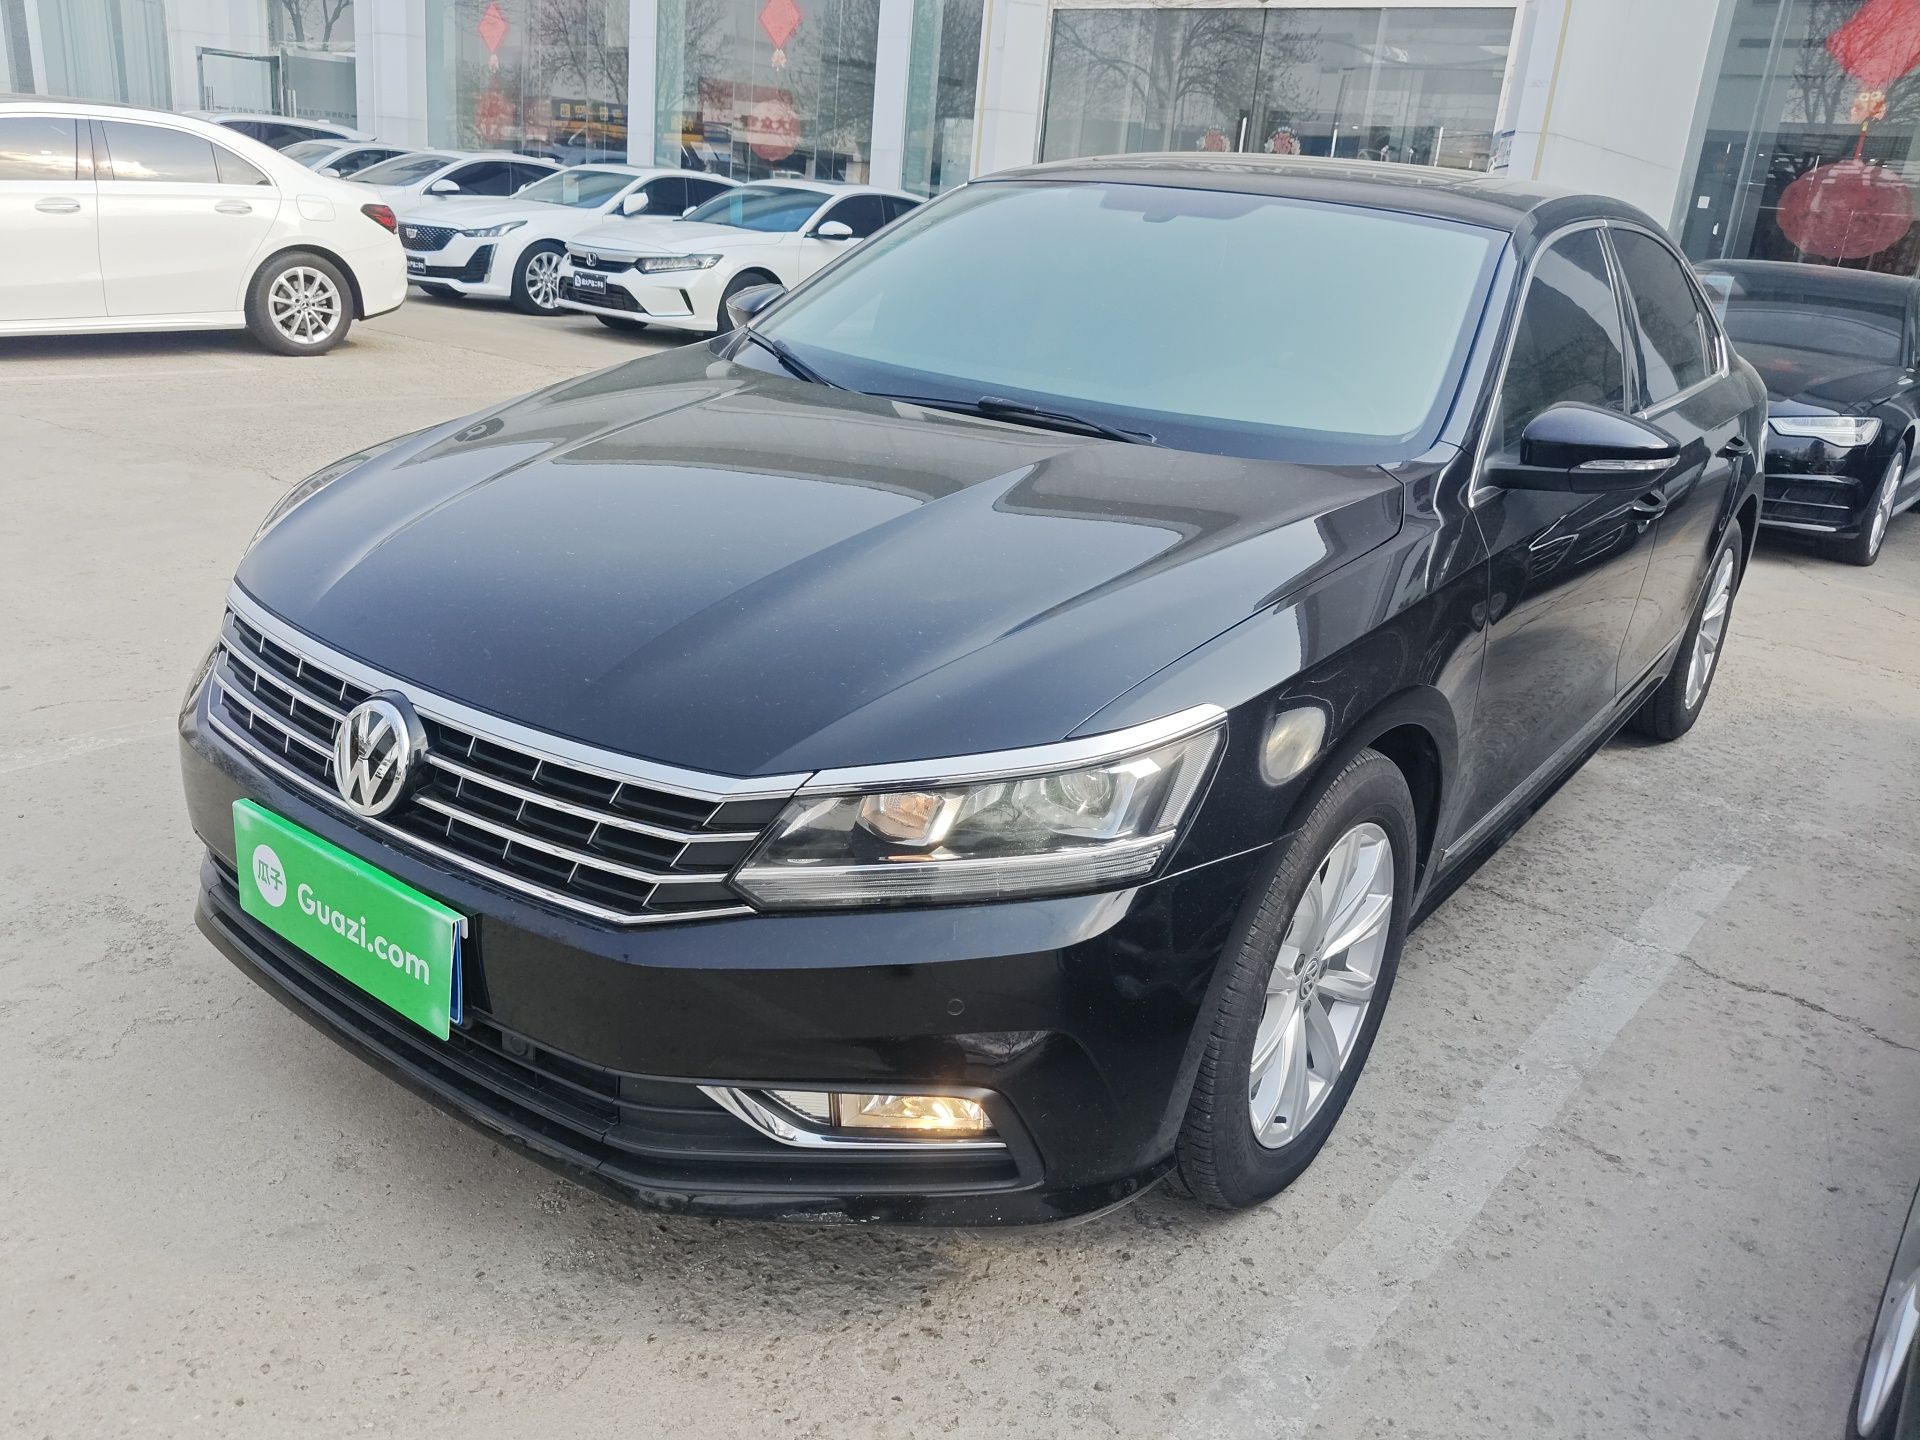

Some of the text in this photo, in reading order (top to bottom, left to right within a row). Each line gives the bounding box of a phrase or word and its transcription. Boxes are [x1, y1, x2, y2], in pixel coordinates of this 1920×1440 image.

[333, 699, 410, 817] VW
[258, 859, 283, 891] 瓜子
[297, 883, 430, 986] Guazi.com
